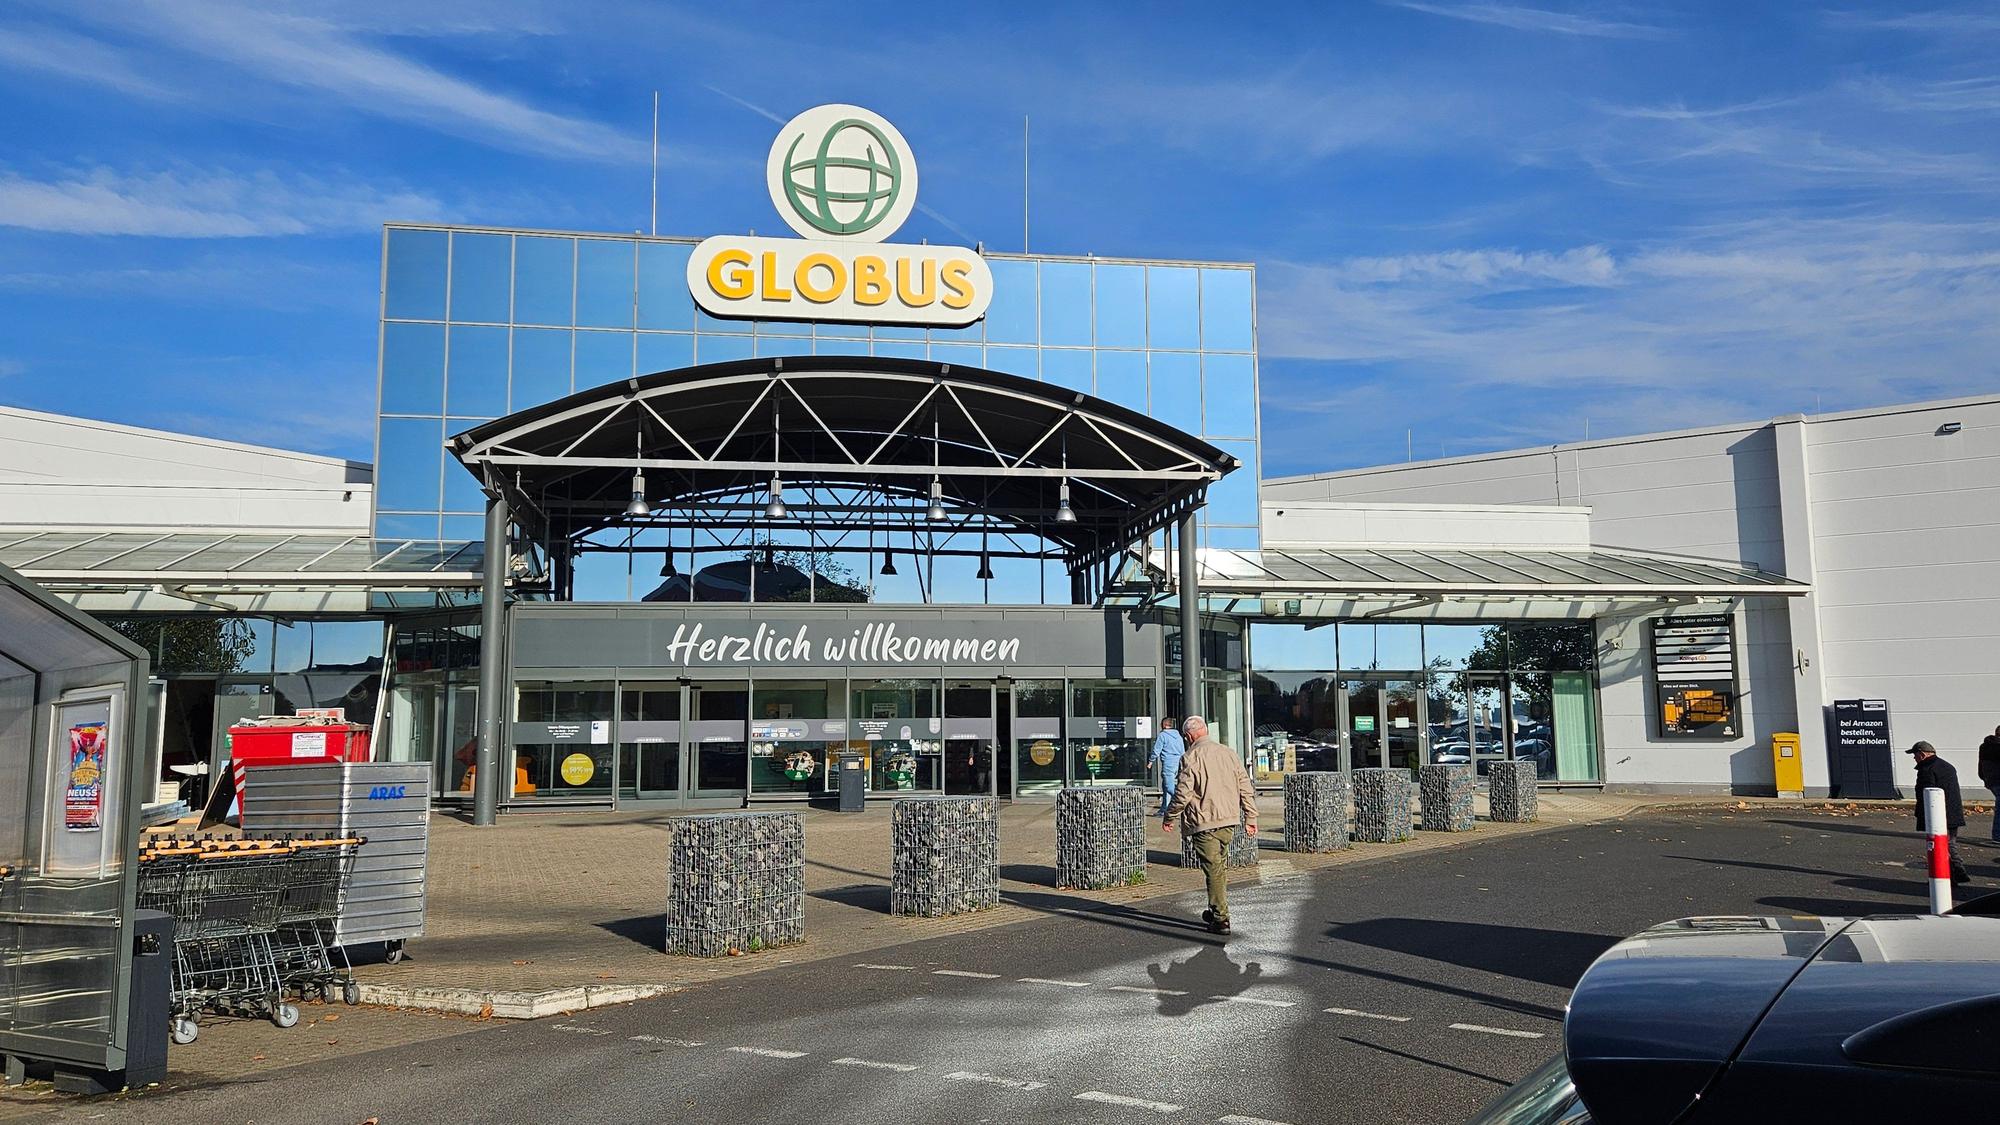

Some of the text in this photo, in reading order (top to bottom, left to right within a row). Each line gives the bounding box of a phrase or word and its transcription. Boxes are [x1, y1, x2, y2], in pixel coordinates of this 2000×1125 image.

[706, 248, 976, 309] GLOBUS
[666, 622, 1020, 667] Herzlich willkommen
[1840, 729, 1876, 737] bestellen,
[67, 788, 98, 797] NEUSS
[368, 785, 406, 801] ARAS
